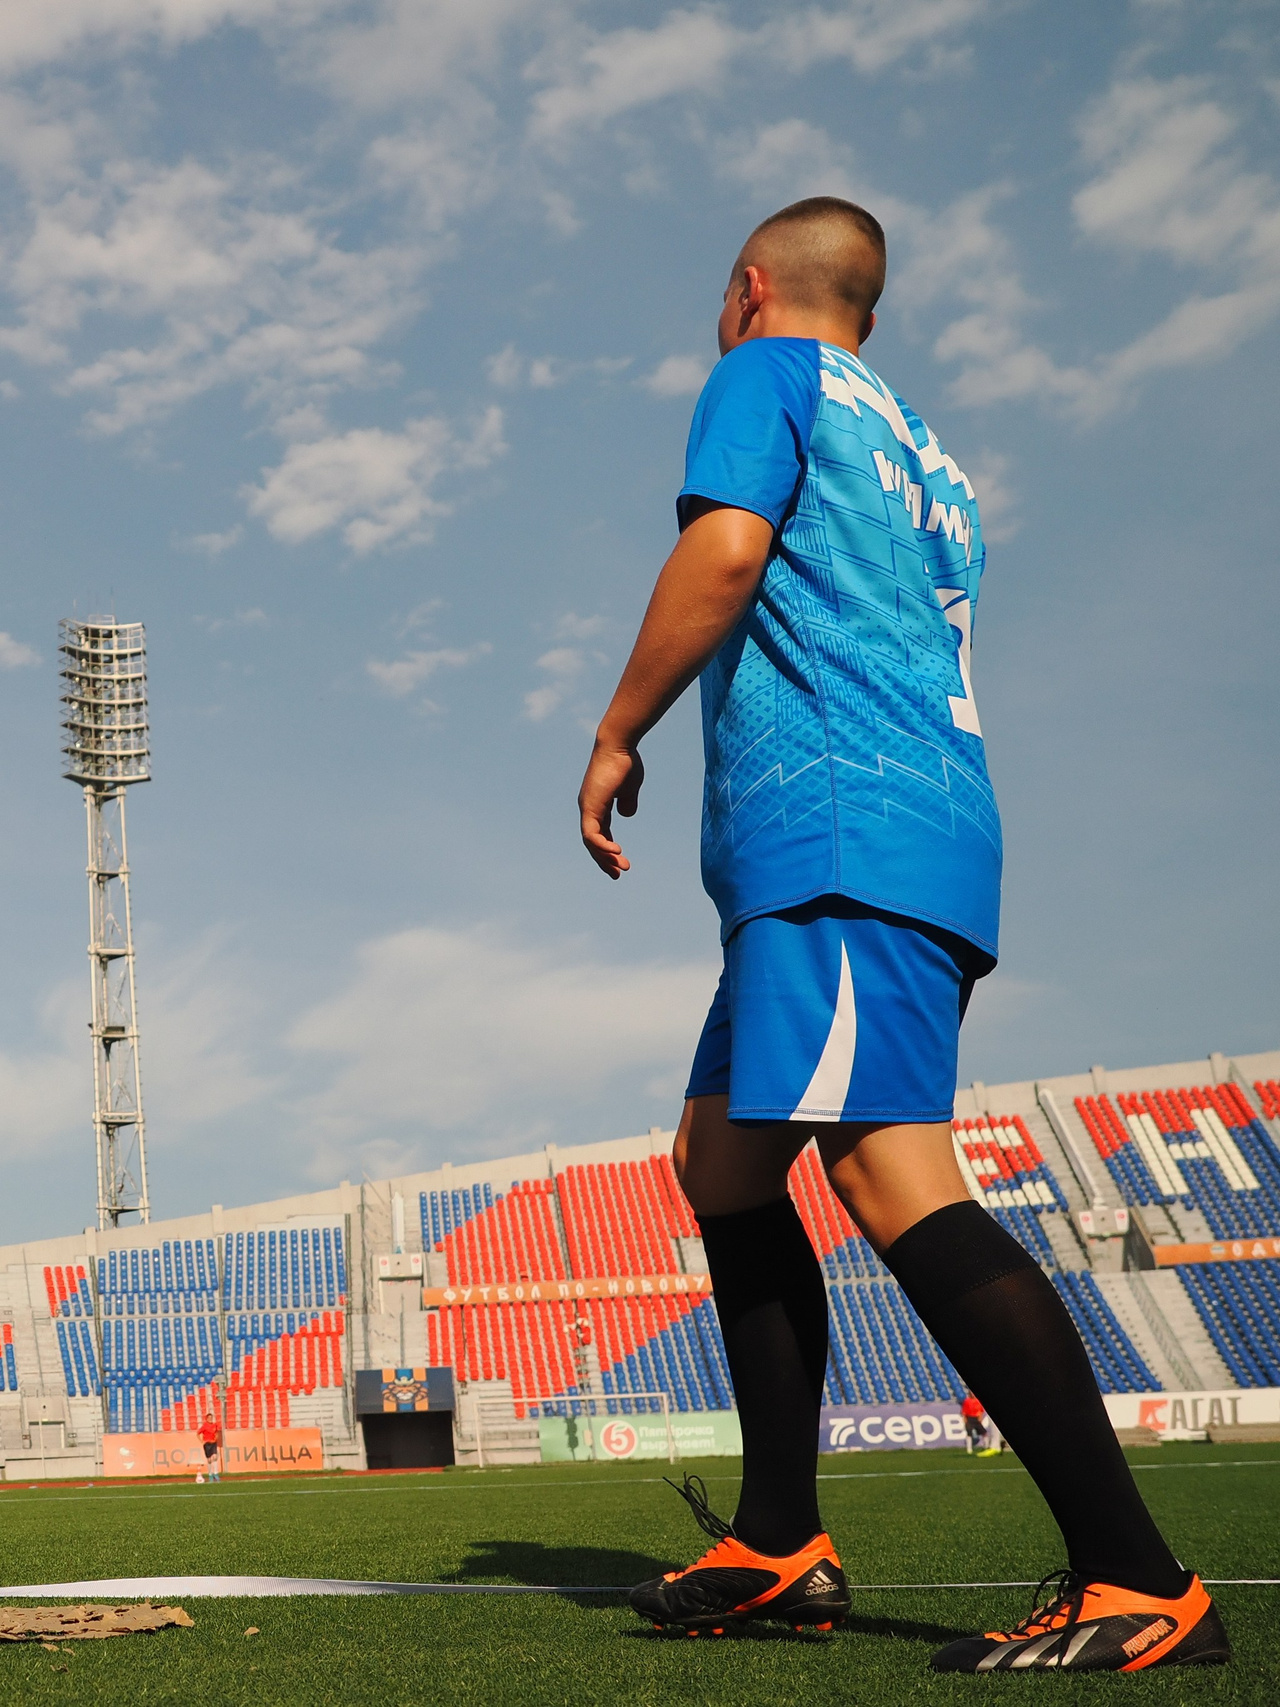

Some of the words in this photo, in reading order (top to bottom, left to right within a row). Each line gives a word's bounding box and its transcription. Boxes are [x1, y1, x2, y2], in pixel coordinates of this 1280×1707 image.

[443, 1283, 541, 1302] ФУТБОЛ
[558, 1276, 705, 1297] ПО-НОВОМУ
[1171, 1397, 1242, 1430] АГАТ
[154, 1447, 205, 1467] ДОД
[225, 1444, 313, 1465] ПИЦЦА
[641, 1437, 715, 1451] вырчает!
[805, 1583, 839, 1596] adidas
